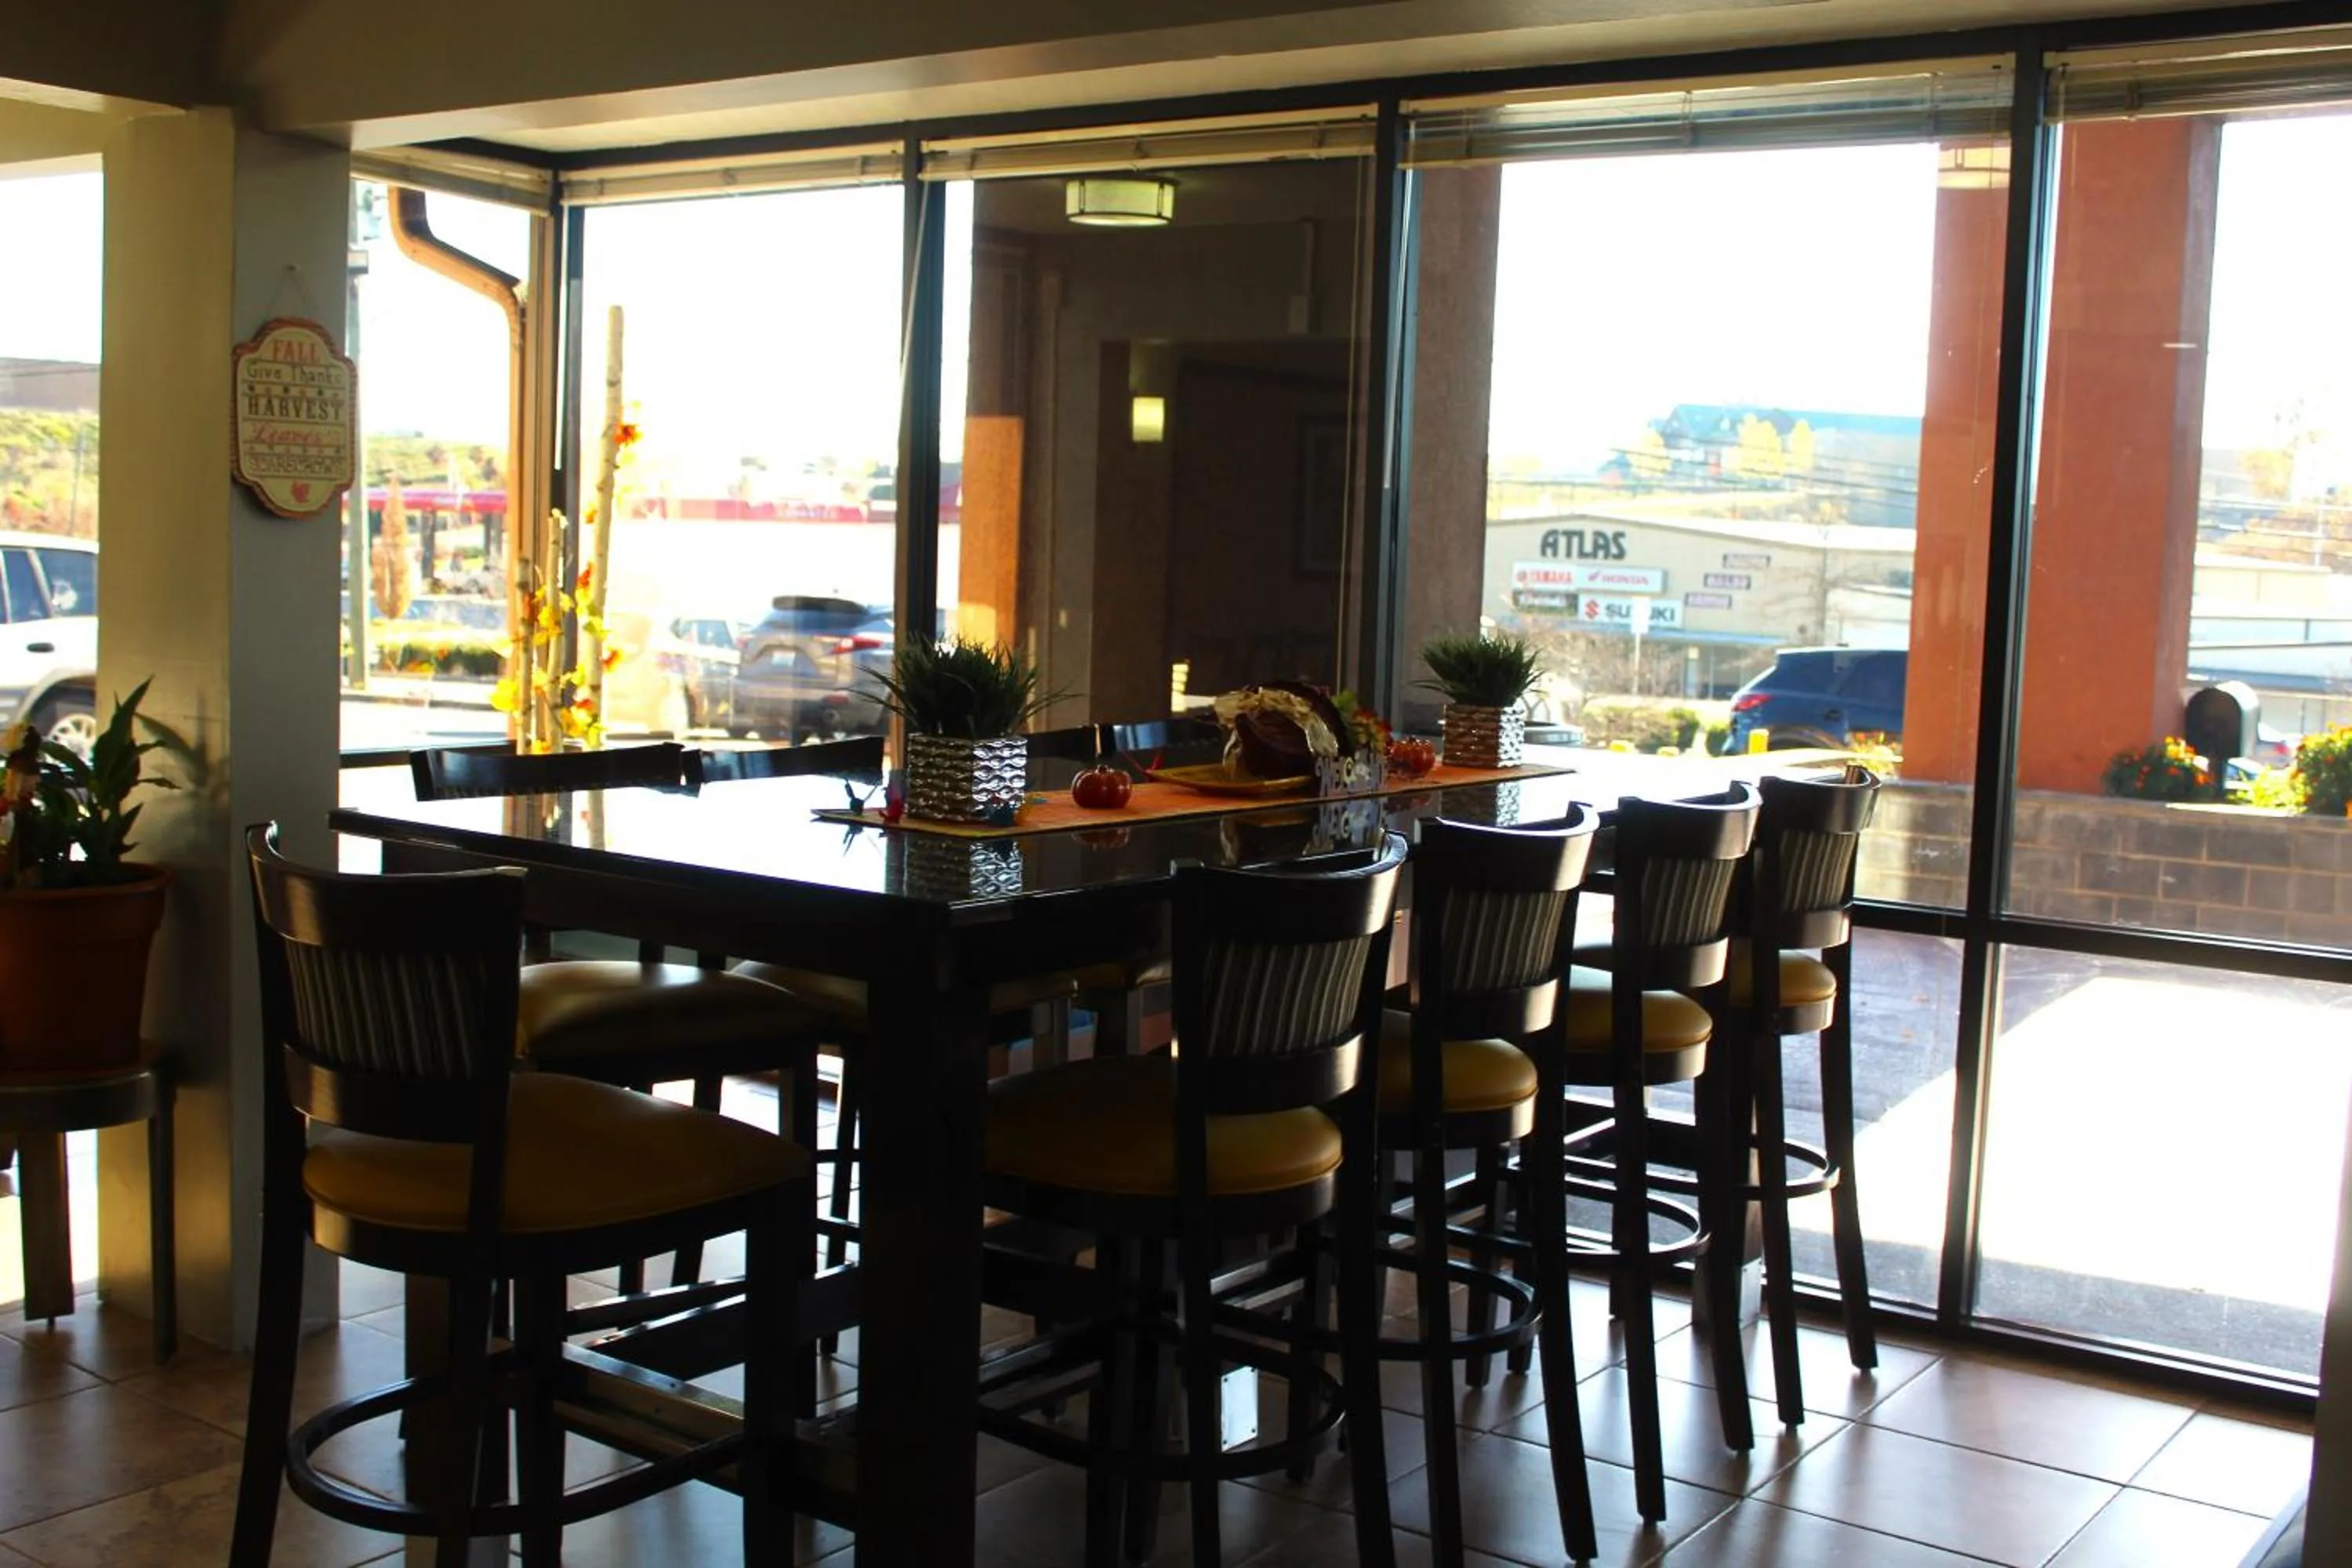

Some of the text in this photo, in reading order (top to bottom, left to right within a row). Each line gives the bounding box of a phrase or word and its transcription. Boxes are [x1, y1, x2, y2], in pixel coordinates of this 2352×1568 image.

[272, 339, 321, 362] FALL
[247, 362, 343, 384] Give Thanks
[248, 396, 345, 420] HARVEST
[1540, 528, 1628, 561] ATLAS
[1530, 570, 1573, 583] YAMAHA
[1602, 574, 1649, 586] HONDA
[1605, 604, 1675, 621] SUUKI
